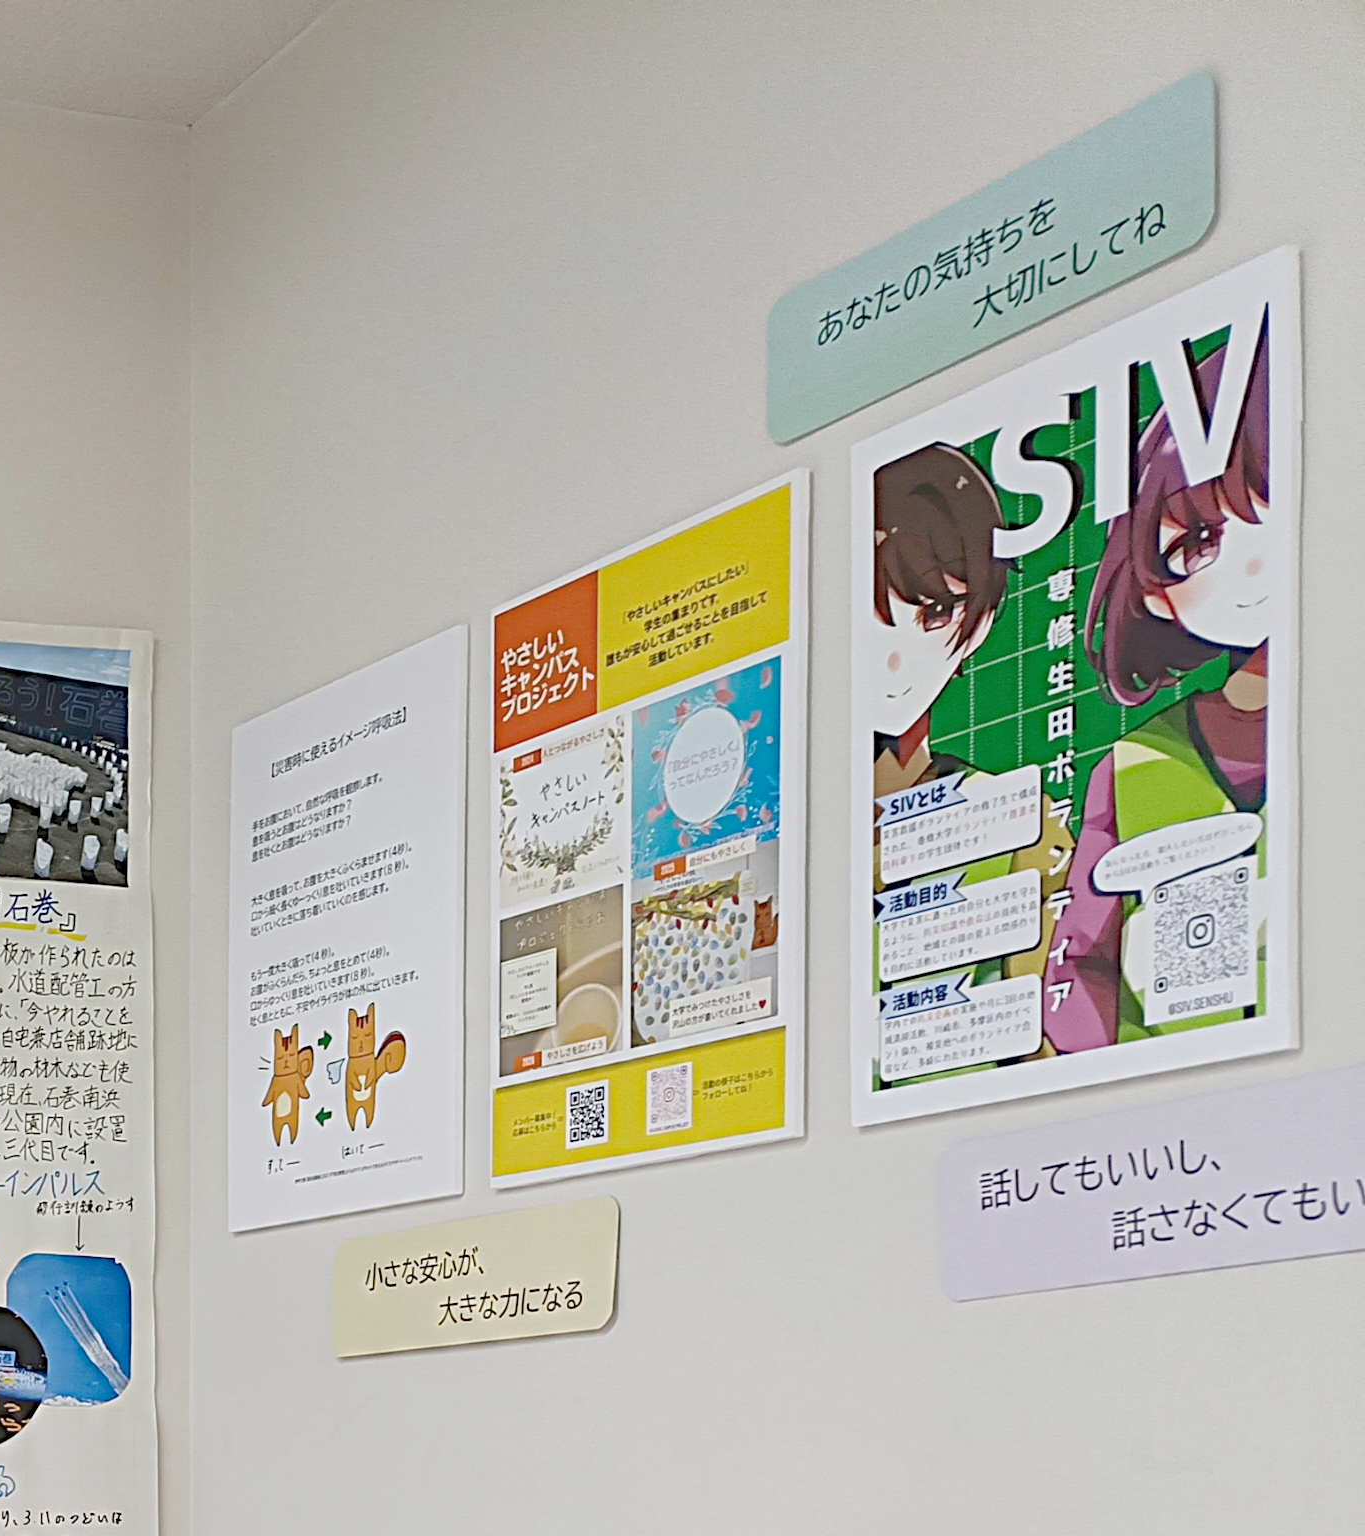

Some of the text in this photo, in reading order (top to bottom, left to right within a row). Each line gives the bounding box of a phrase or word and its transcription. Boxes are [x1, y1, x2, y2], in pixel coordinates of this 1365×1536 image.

[817, 197, 1057, 347] あなたの気持ちを
[972, 202, 1167, 328] 大切にしてね
[992, 306, 1268, 559] SIV
[500, 648, 579, 696] キャンパス
[501, 629, 564, 674] やさしい
[501, 666, 595, 723] プロジェクト
[271, 706, 407, 778] 【災害時に使えるイメージ呼吸法】
[539, 771, 587, 801] やさしい
[890, 784, 947, 816] SIVとは
[1046, 568, 1076, 1013] 専修生田ボランティア
[531, 793, 606, 830] キャンパスノート
[889, 884, 947, 912] 活動目的
[893, 984, 948, 1011] 活動内容
[1169, 991, 1233, 1015] @SIV.SENSHU
[980, 1138, 1224, 1212] 話してもいいし、
[365, 1249, 486, 1292] 小さな安心が、
[438, 1283, 584, 1327] 大きな力になる
